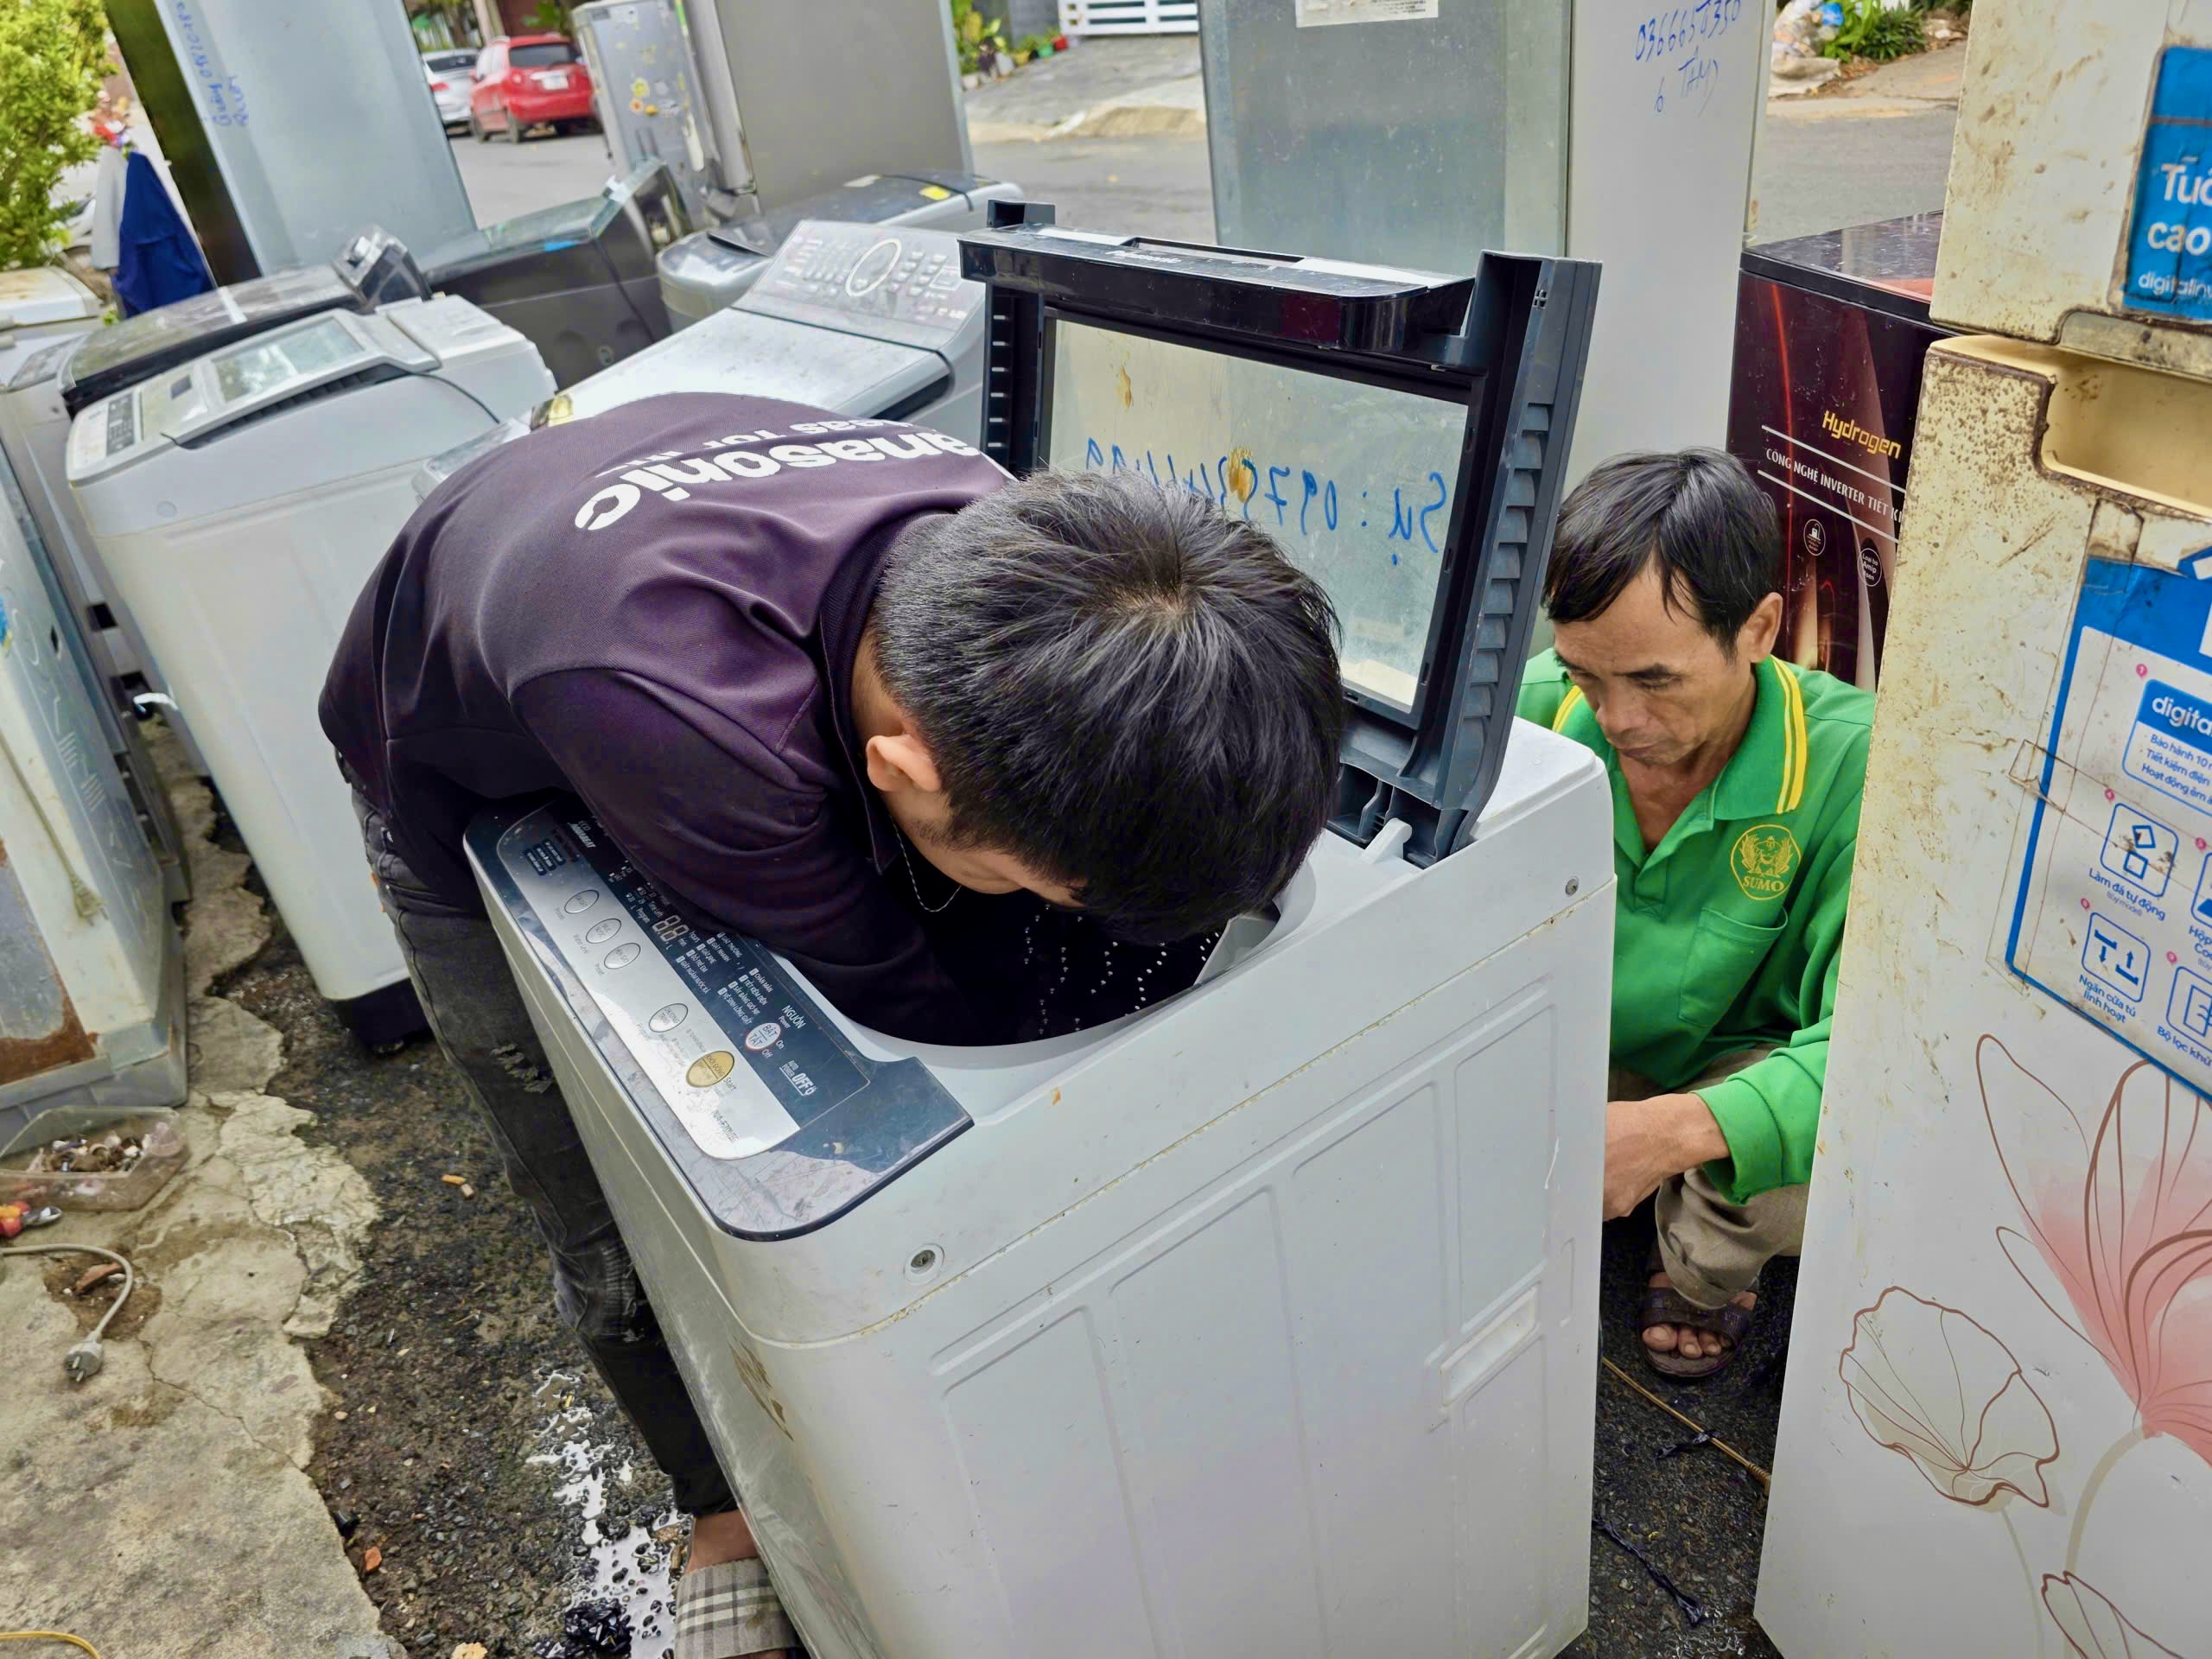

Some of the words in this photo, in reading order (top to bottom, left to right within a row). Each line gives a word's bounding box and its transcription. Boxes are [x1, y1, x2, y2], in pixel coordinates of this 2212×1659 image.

[2147, 221, 2211, 255] cao
[1822, 410, 1901, 459] Hydrogen
[575, 429, 982, 531] anasonic
[1821, 473, 1865, 505] INVERTER
[2196, 754, 2208, 768] 10
[1743, 875, 1784, 892] SUMO
[2088, 868, 2111, 887] Làm
[2139, 897, 2166, 921] động
[2083, 990, 2102, 1007] linh
[778, 1015, 791, 1029] Power
[776, 1039, 785, 1049] On
[761, 1049, 773, 1058] Off
[781, 1063, 795, 1078] POWER
[723, 1077, 737, 1092] Start
[791, 1072, 814, 1090] OFF
